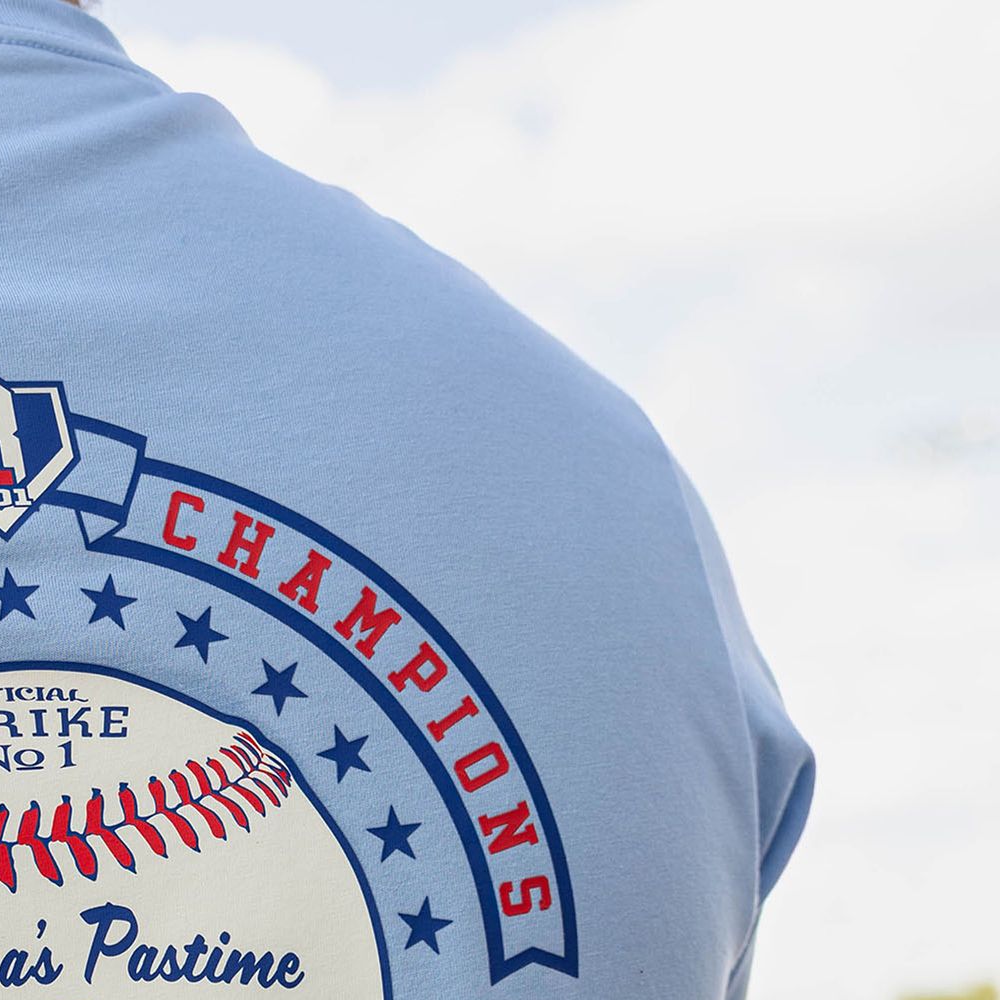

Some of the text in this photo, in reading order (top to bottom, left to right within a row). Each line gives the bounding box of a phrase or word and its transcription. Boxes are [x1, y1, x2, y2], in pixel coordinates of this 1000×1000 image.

[162, 490, 553, 917] CHAMPIONS
[57, 740, 77, 769] 1
[79, 902, 305, 990] Pastime
